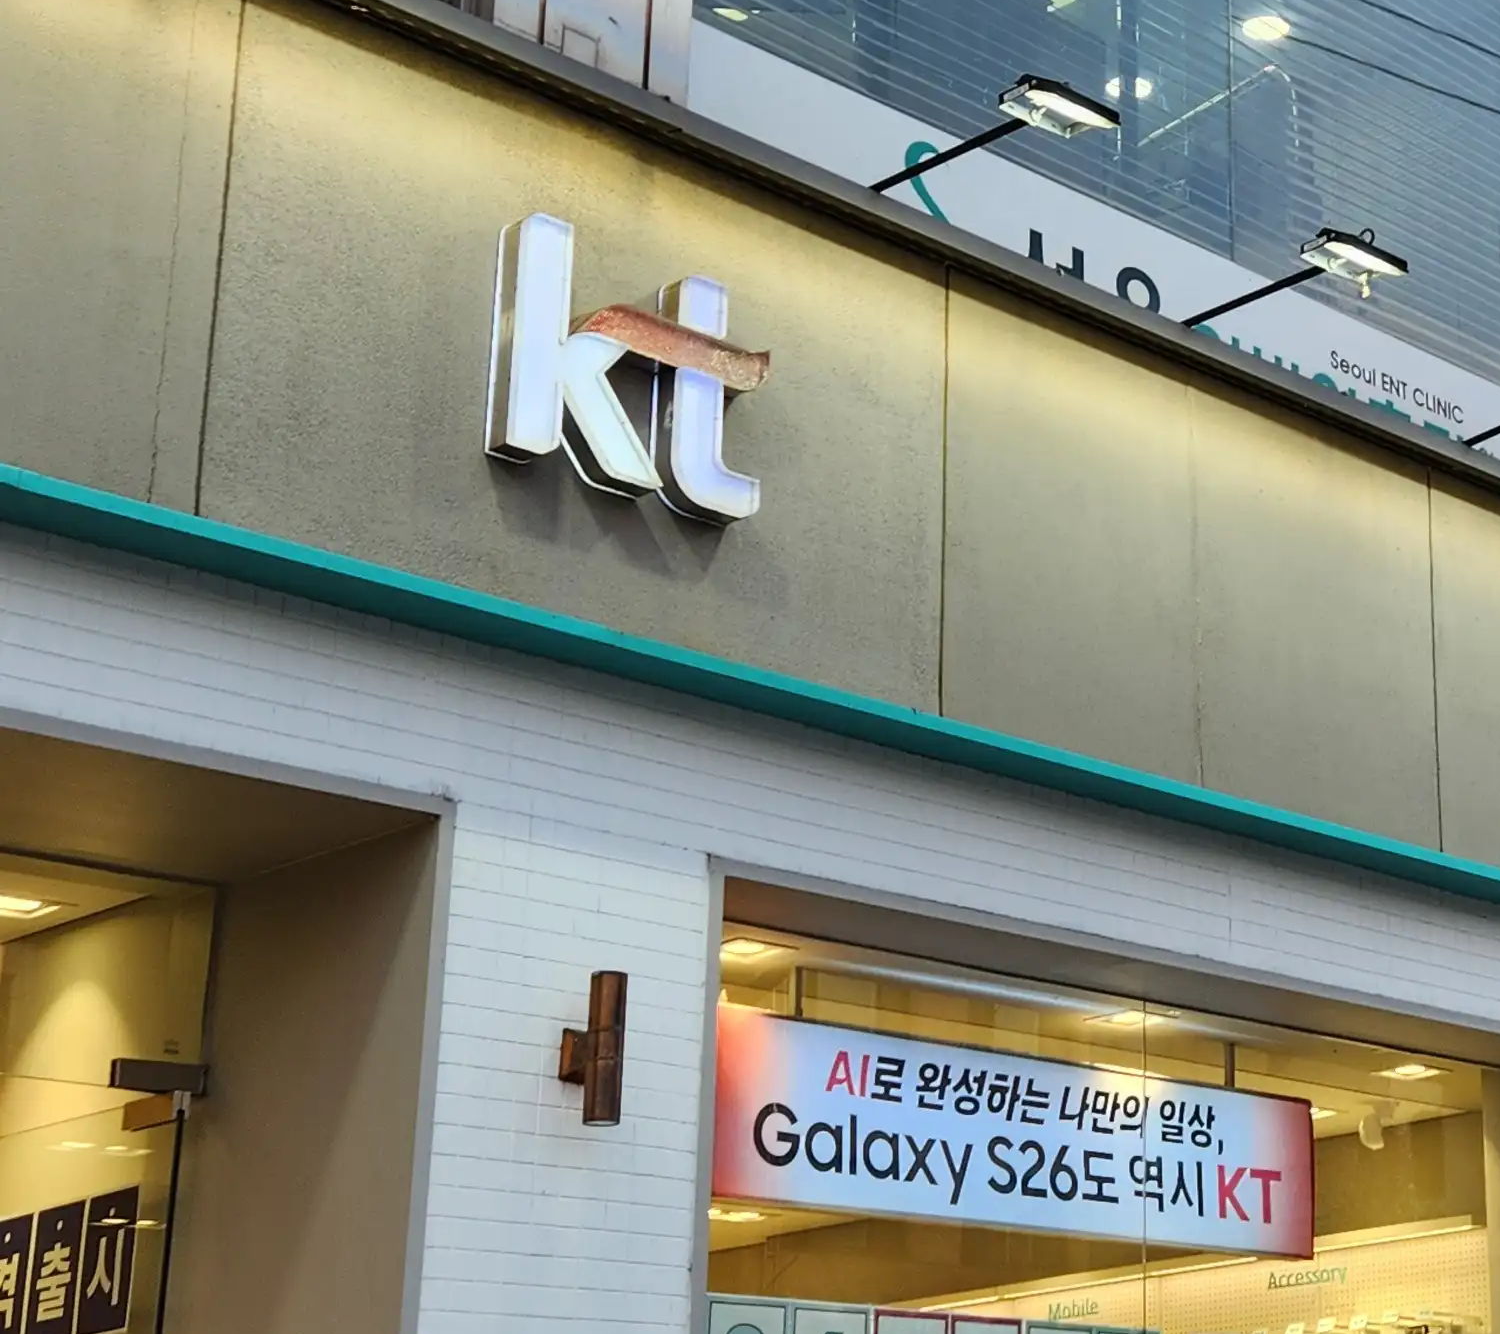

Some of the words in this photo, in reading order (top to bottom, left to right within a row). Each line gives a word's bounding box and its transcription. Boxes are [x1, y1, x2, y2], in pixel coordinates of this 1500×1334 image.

[490, 211, 771, 523] kt
[1330, 350, 1377, 387] Seoul
[1381, 372, 1408, 400] ENT
[1412, 387, 1465, 424] CLINIC
[825, 1050, 906, 1104] AI로
[916, 1062, 1051, 1126] 완성하는
[1058, 1091, 1147, 1139] 나만의
[1159, 1099, 1224, 1157] 일상,
[752, 1102, 972, 1205] Galaxy
[988, 1136, 1120, 1207] S26도
[1130, 1146, 1205, 1217] 역시
[1217, 1164, 1282, 1225] KT
[1047, 1297, 1100, 1322] Mobile
[1266, 1265, 1348, 1291] Accessory
